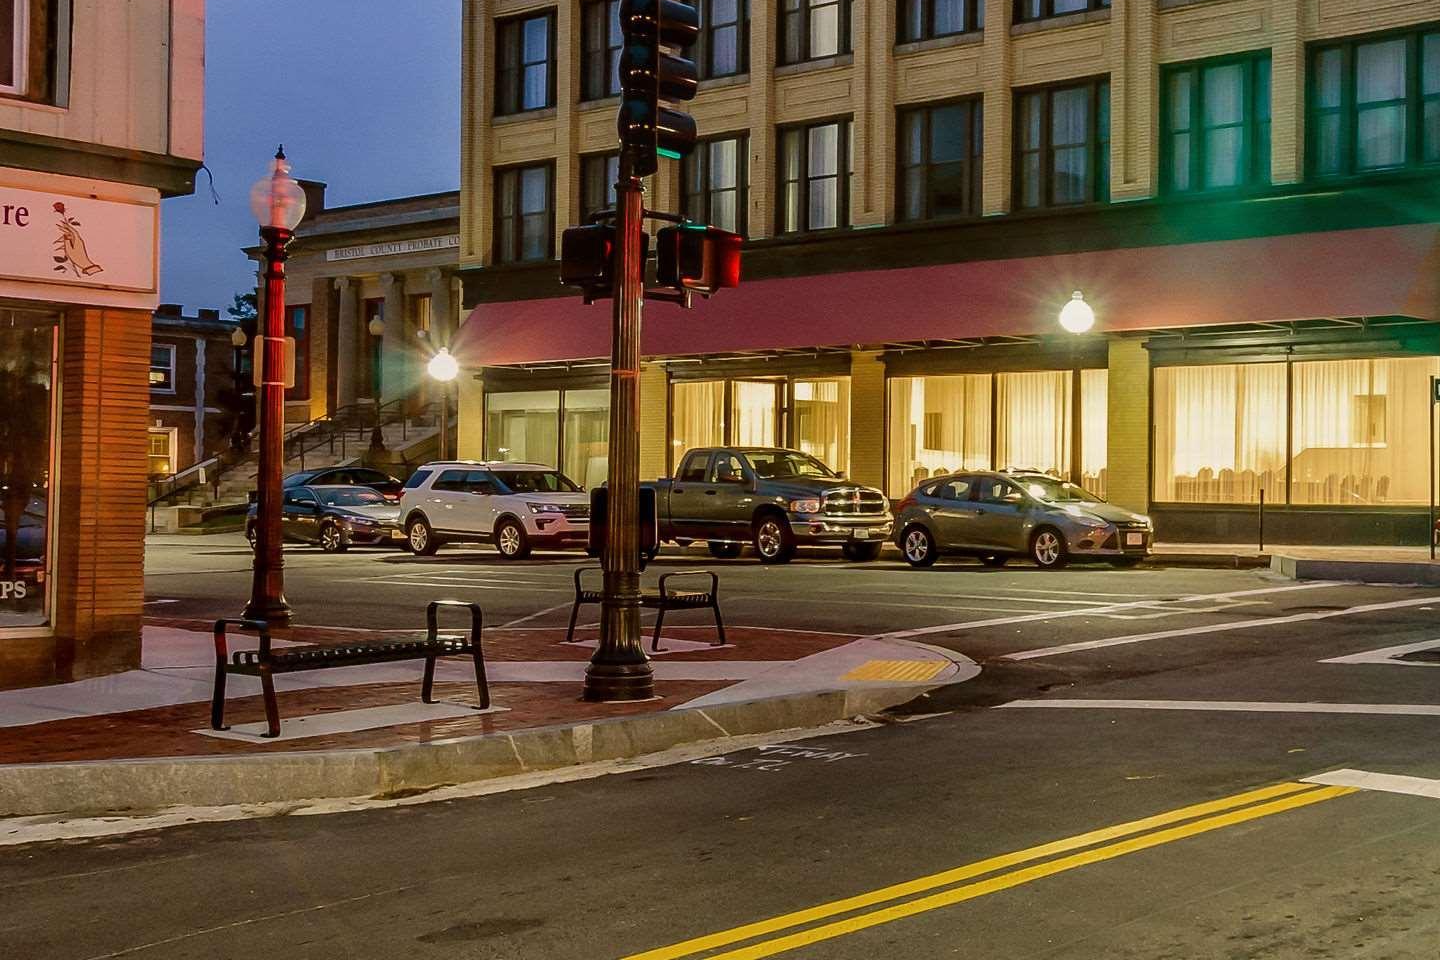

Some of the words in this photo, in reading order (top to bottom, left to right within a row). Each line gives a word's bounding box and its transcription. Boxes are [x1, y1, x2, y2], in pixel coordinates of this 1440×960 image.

[2, 205, 30, 227] re
[334, 247, 365, 258] BRISTOL
[370, 243, 402, 254] COUNTY
[407, 238, 443, 251] PROBATE
[0, 581, 27, 599] PS
